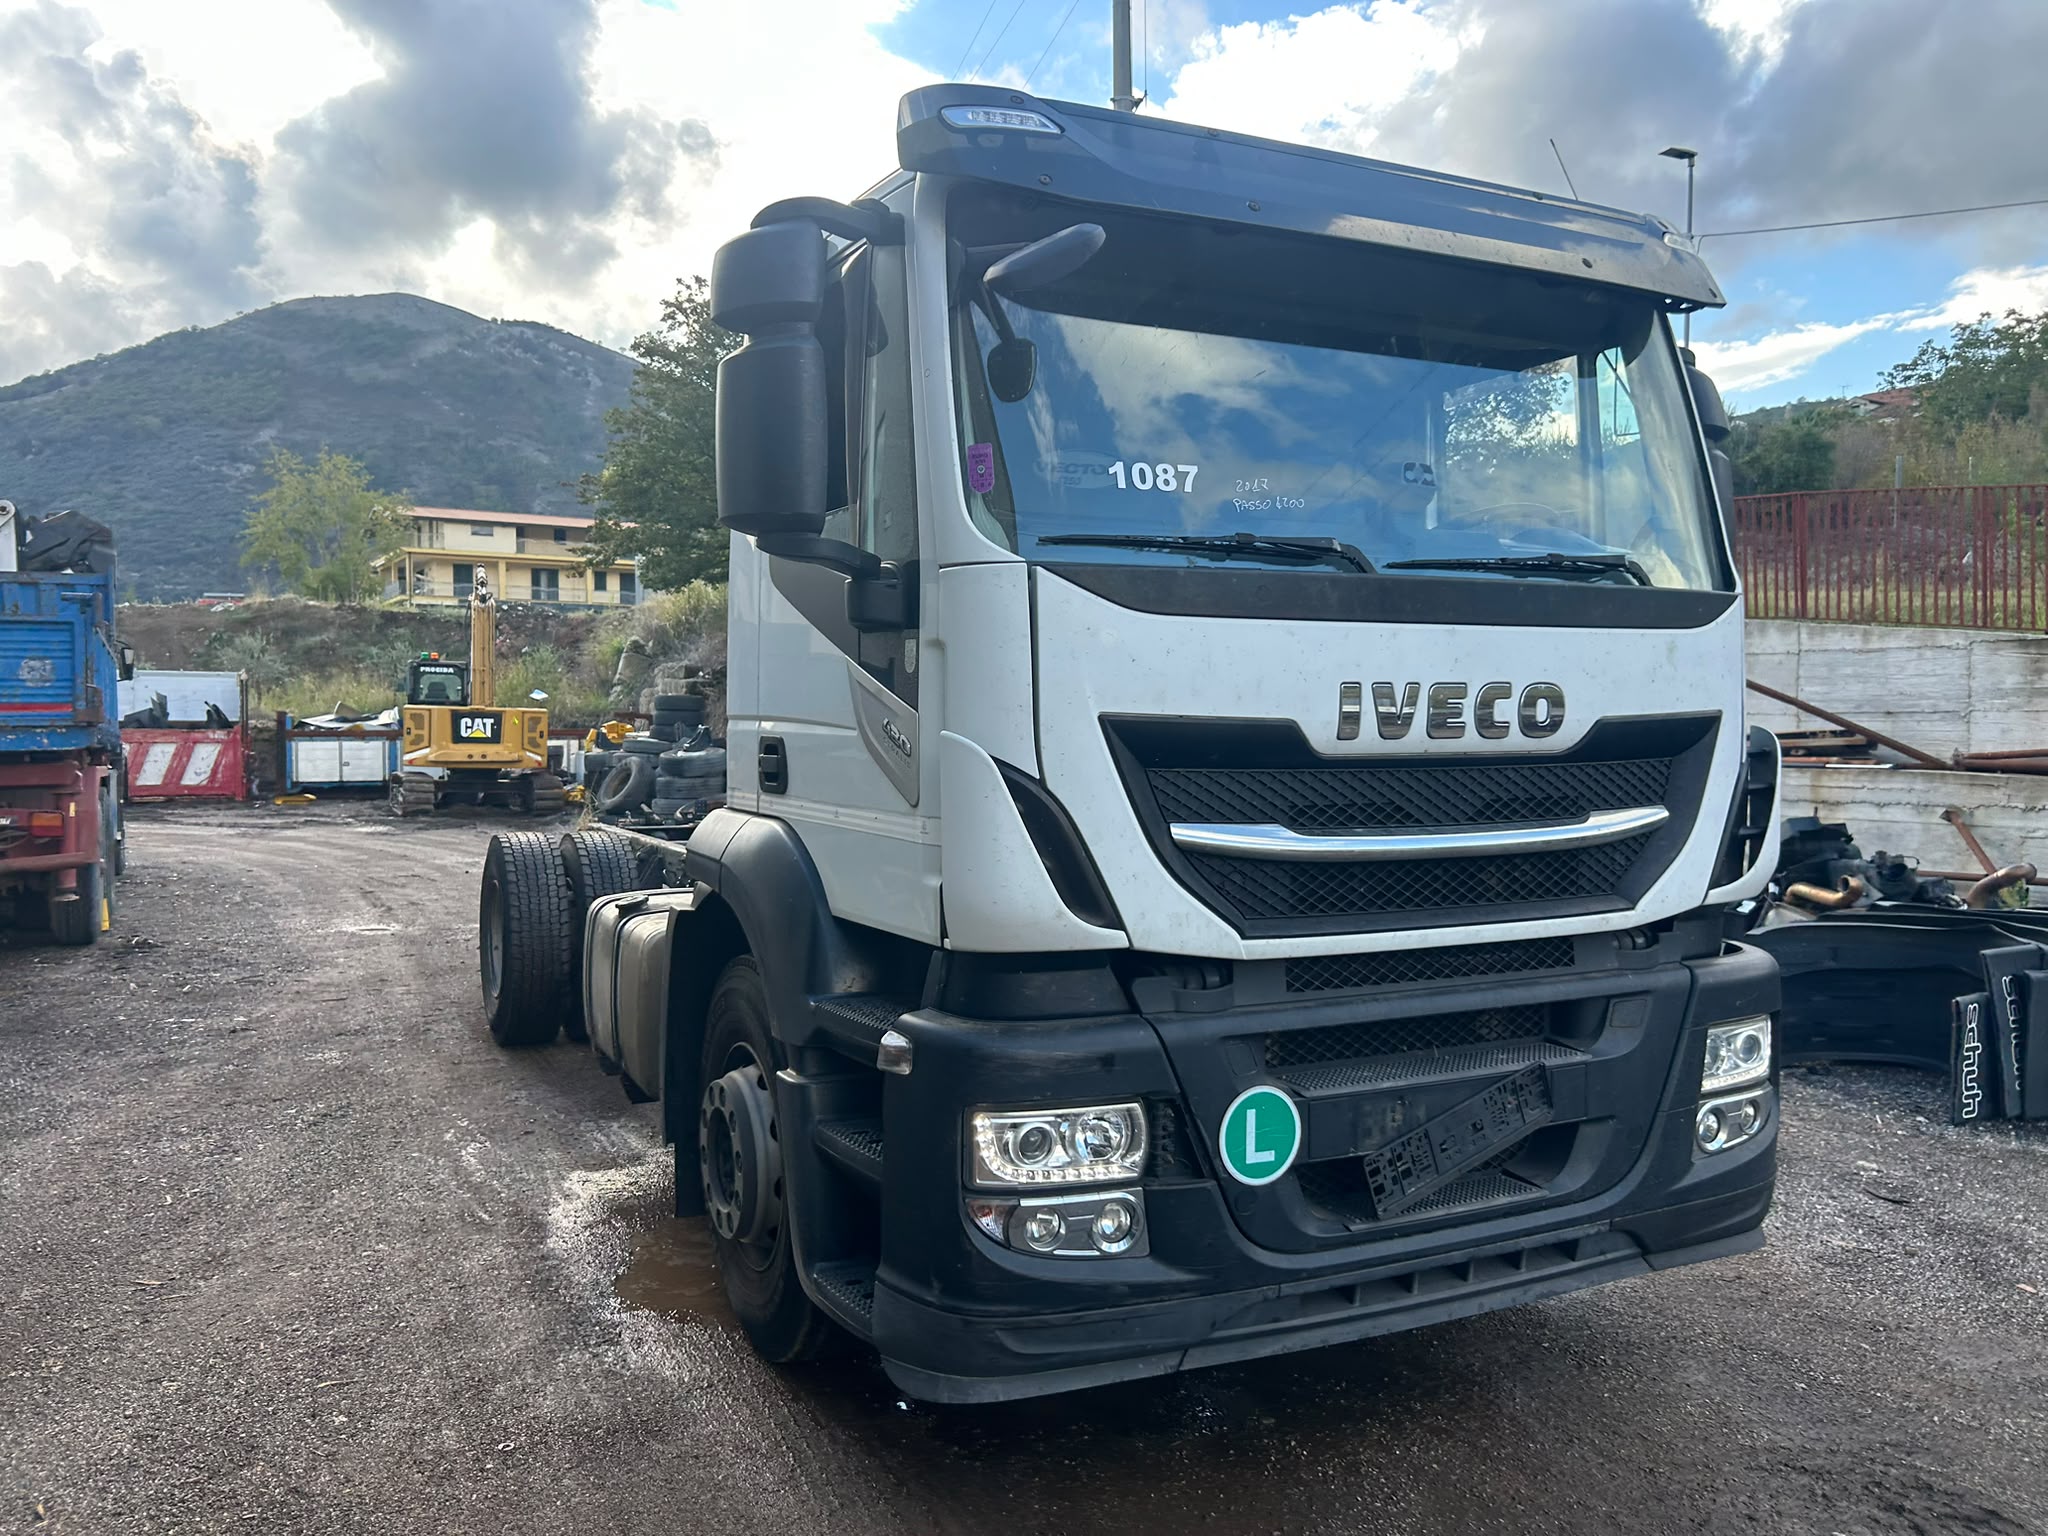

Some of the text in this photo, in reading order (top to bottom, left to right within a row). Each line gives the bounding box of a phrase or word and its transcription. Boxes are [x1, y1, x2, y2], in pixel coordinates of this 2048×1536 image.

[1108, 461, 1199, 493] 1087
[1235, 478, 1269, 492] 2017
[1232, 498, 1272, 513] PASSO
[1336, 681, 1566, 741] IVECO
[460, 717, 495, 738] CAT
[1962, 1003, 1982, 1118] schuh
[1245, 1108, 1276, 1165] L
